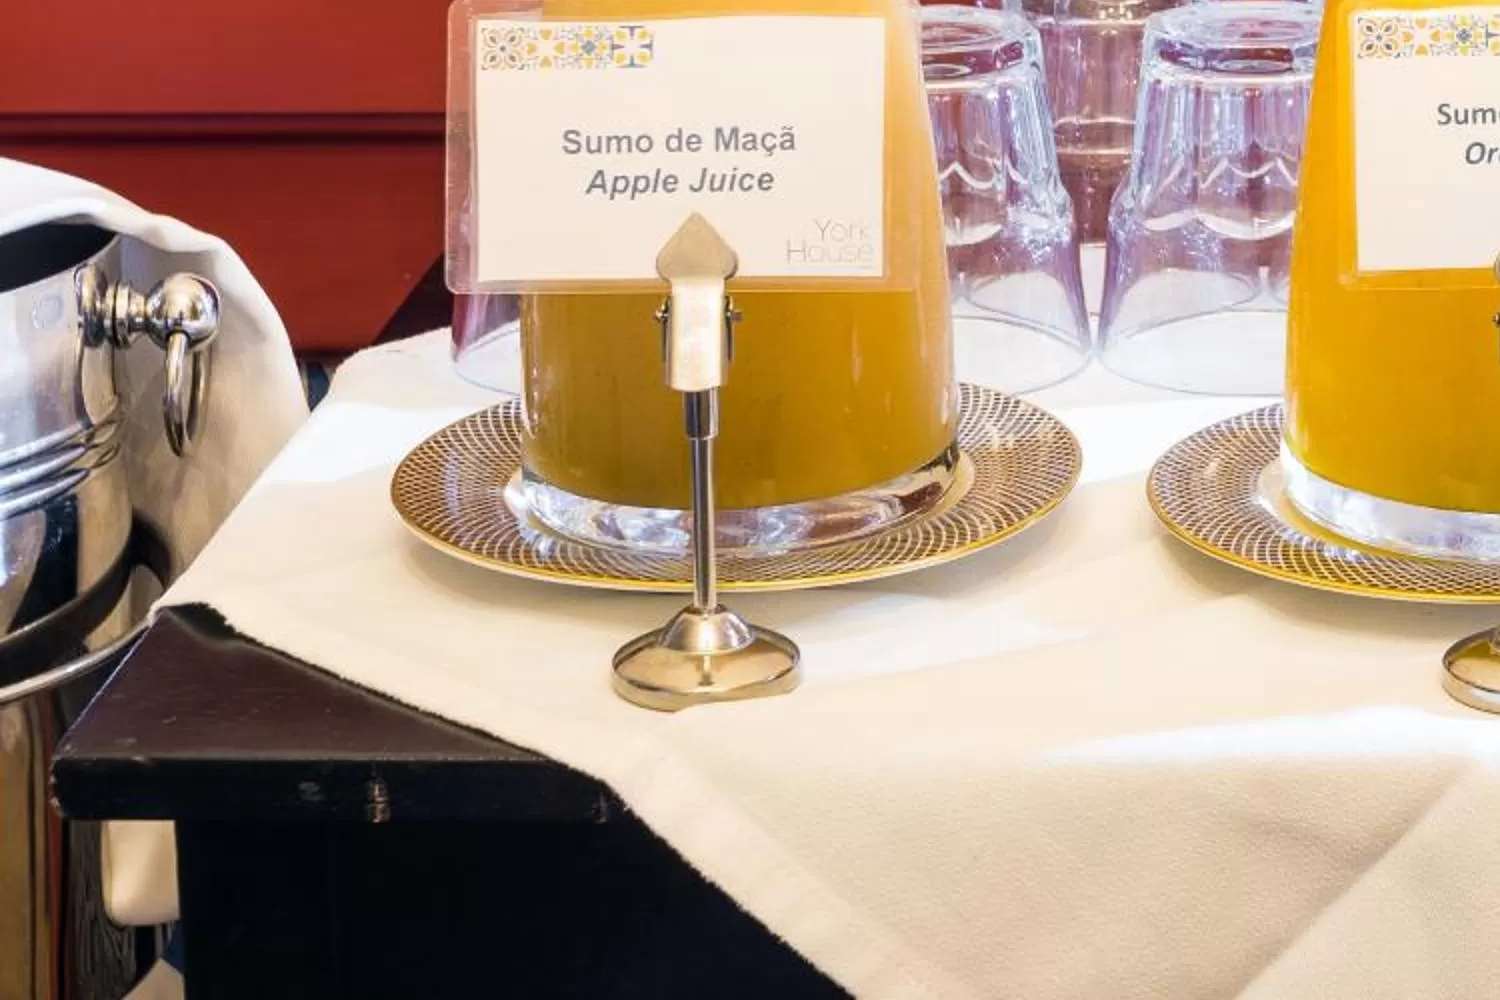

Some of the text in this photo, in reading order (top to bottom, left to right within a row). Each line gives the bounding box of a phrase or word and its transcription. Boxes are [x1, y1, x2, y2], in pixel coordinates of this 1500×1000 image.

[561, 125, 797, 158] Sumo de Maçã
[584, 166, 776, 201] Apple Juice
[813, 217, 873, 242] York
[785, 238, 875, 264] House
